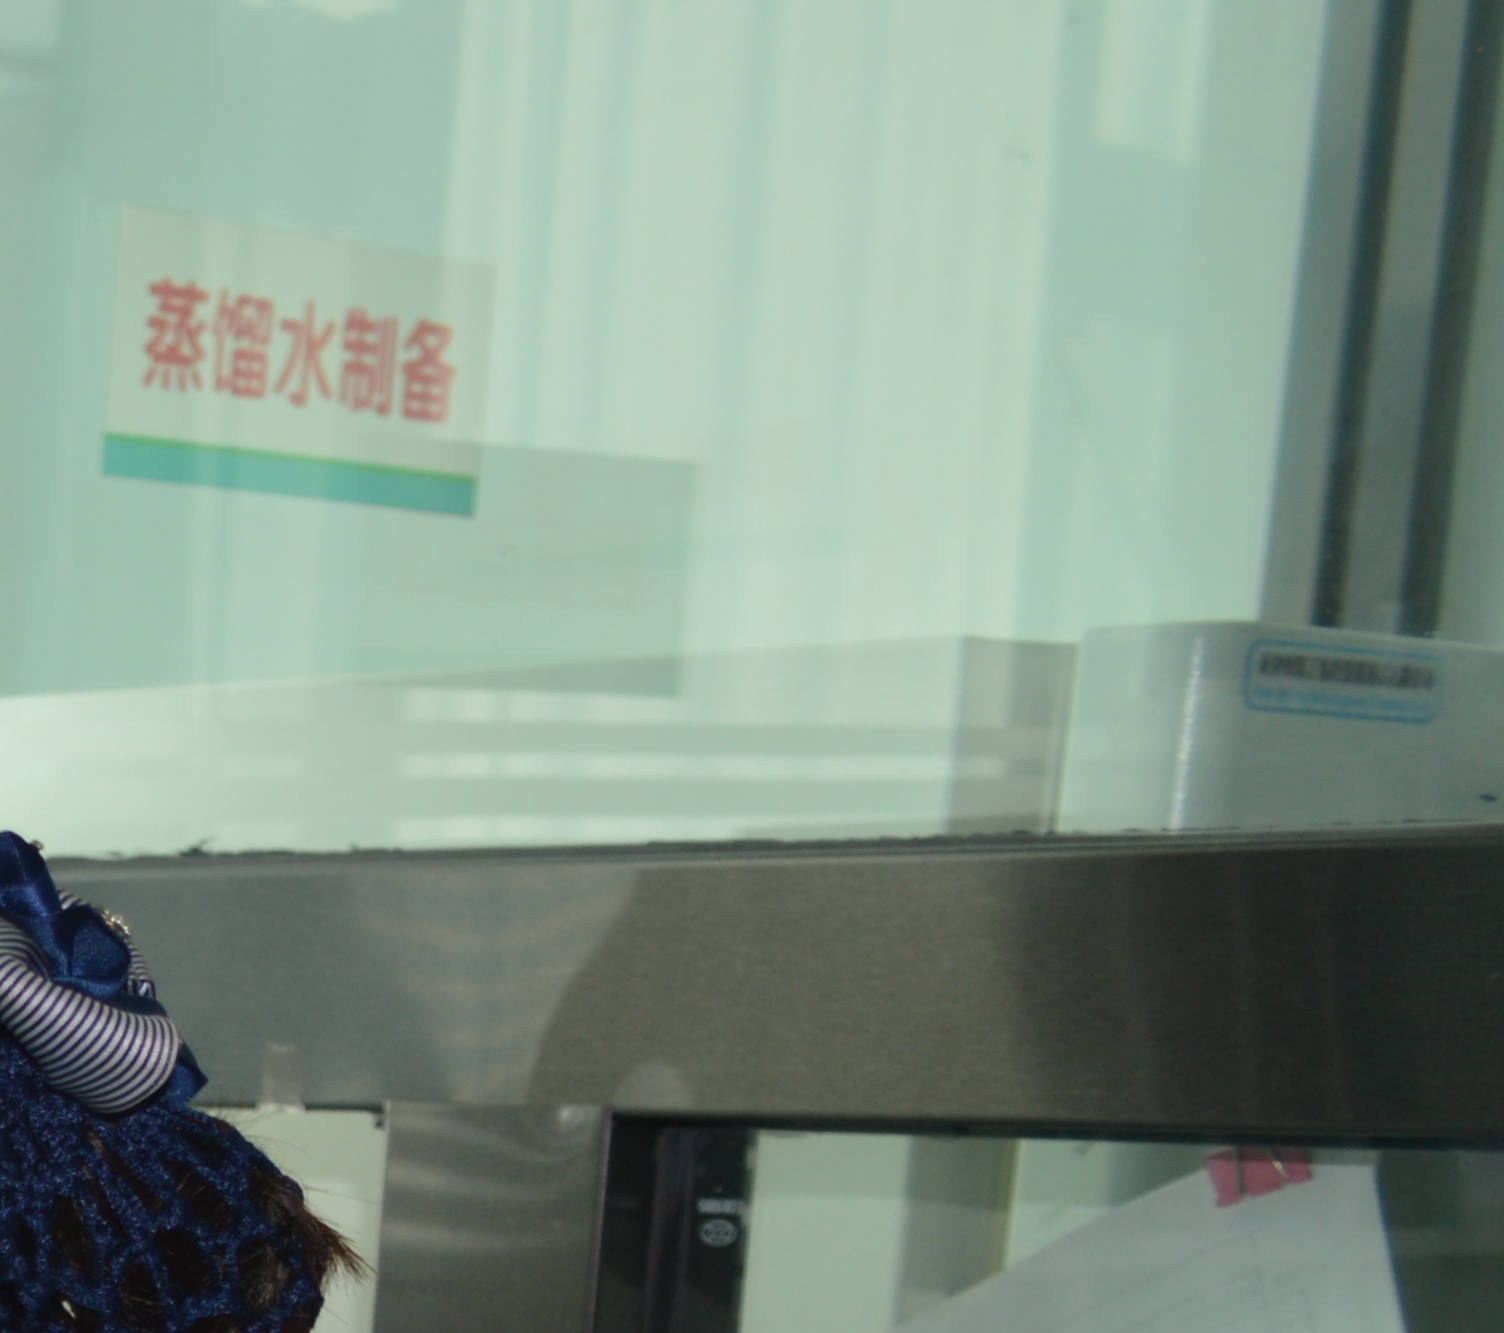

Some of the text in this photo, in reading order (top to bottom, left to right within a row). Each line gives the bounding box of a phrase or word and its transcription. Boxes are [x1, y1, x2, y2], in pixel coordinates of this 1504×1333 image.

[142, 276, 456, 424] 蒸馏水制备
